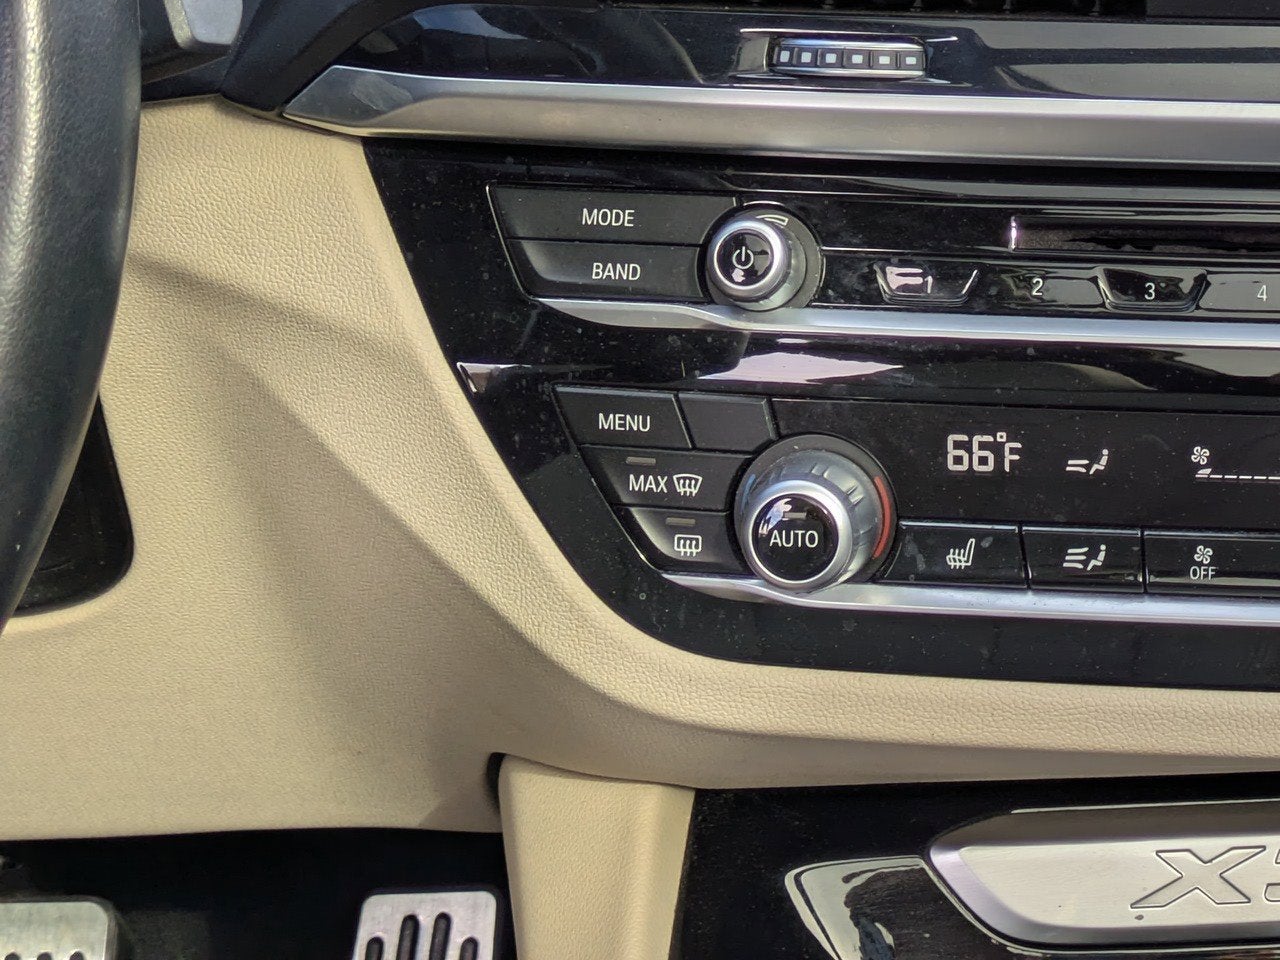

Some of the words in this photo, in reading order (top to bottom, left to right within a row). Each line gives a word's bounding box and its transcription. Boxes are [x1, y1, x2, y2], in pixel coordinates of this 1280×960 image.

[582, 207, 635, 227] MODE
[591, 262, 641, 281] BAND
[923, 275, 933, 294] 1
[1031, 277, 1043, 296] 2
[1144, 282, 1157, 304] 3
[1256, 284, 1267, 302] 4
[598, 412, 651, 432] MENU
[629, 473, 668, 494] MAX
[768, 529, 819, 549] AUTO
[1189, 565, 1217, 581] OFF
